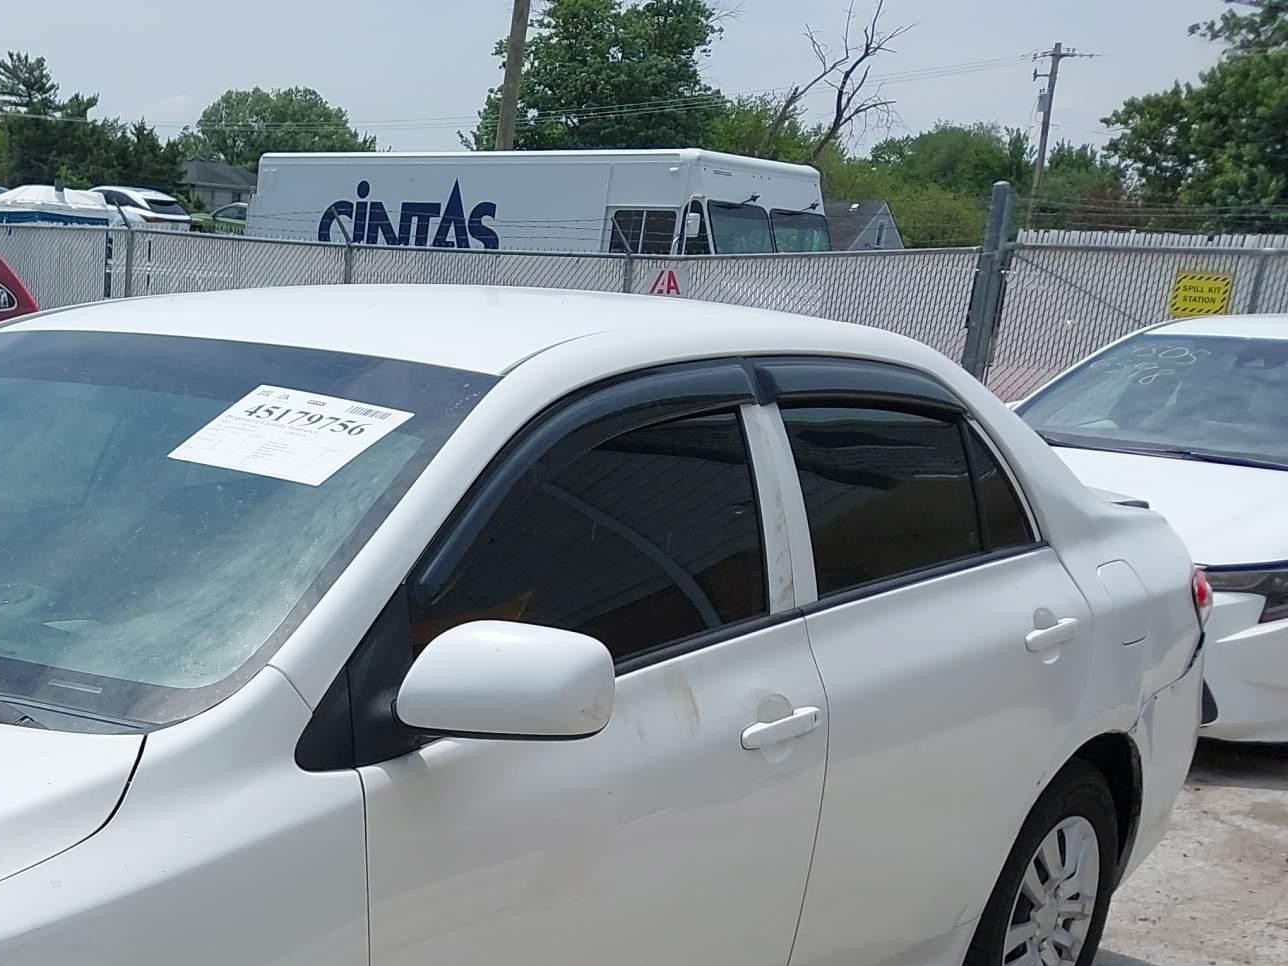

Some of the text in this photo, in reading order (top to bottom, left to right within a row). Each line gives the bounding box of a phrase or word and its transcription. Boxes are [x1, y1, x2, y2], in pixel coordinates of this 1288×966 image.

[1182, 284, 1223, 294] SPILL KIT
[1182, 295, 1217, 305] STATION
[244, 403, 373, 436] 45179756
